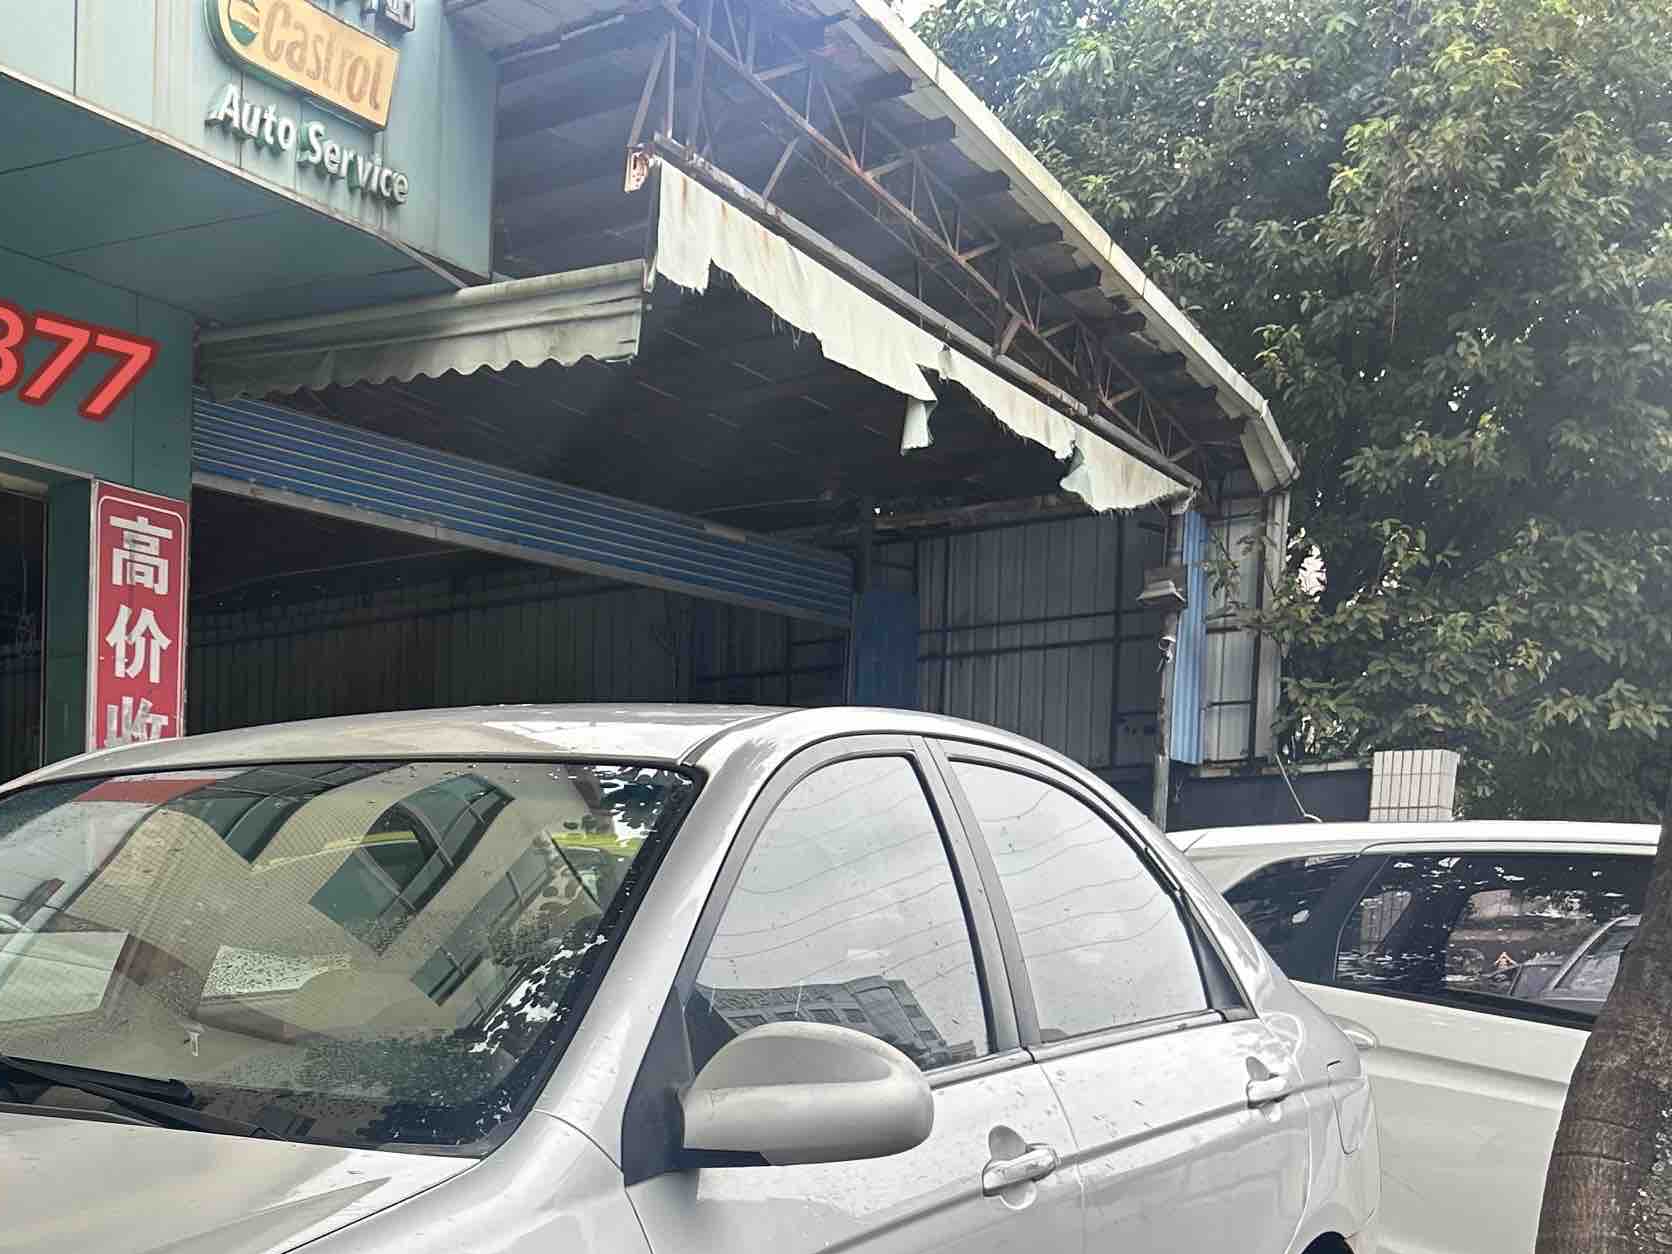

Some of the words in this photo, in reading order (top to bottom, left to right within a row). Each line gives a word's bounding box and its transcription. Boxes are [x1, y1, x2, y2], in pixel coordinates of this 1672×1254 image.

[264, 2, 385, 111] Castrol
[208, 83, 297, 151] Auto
[297, 120, 409, 204] Service
